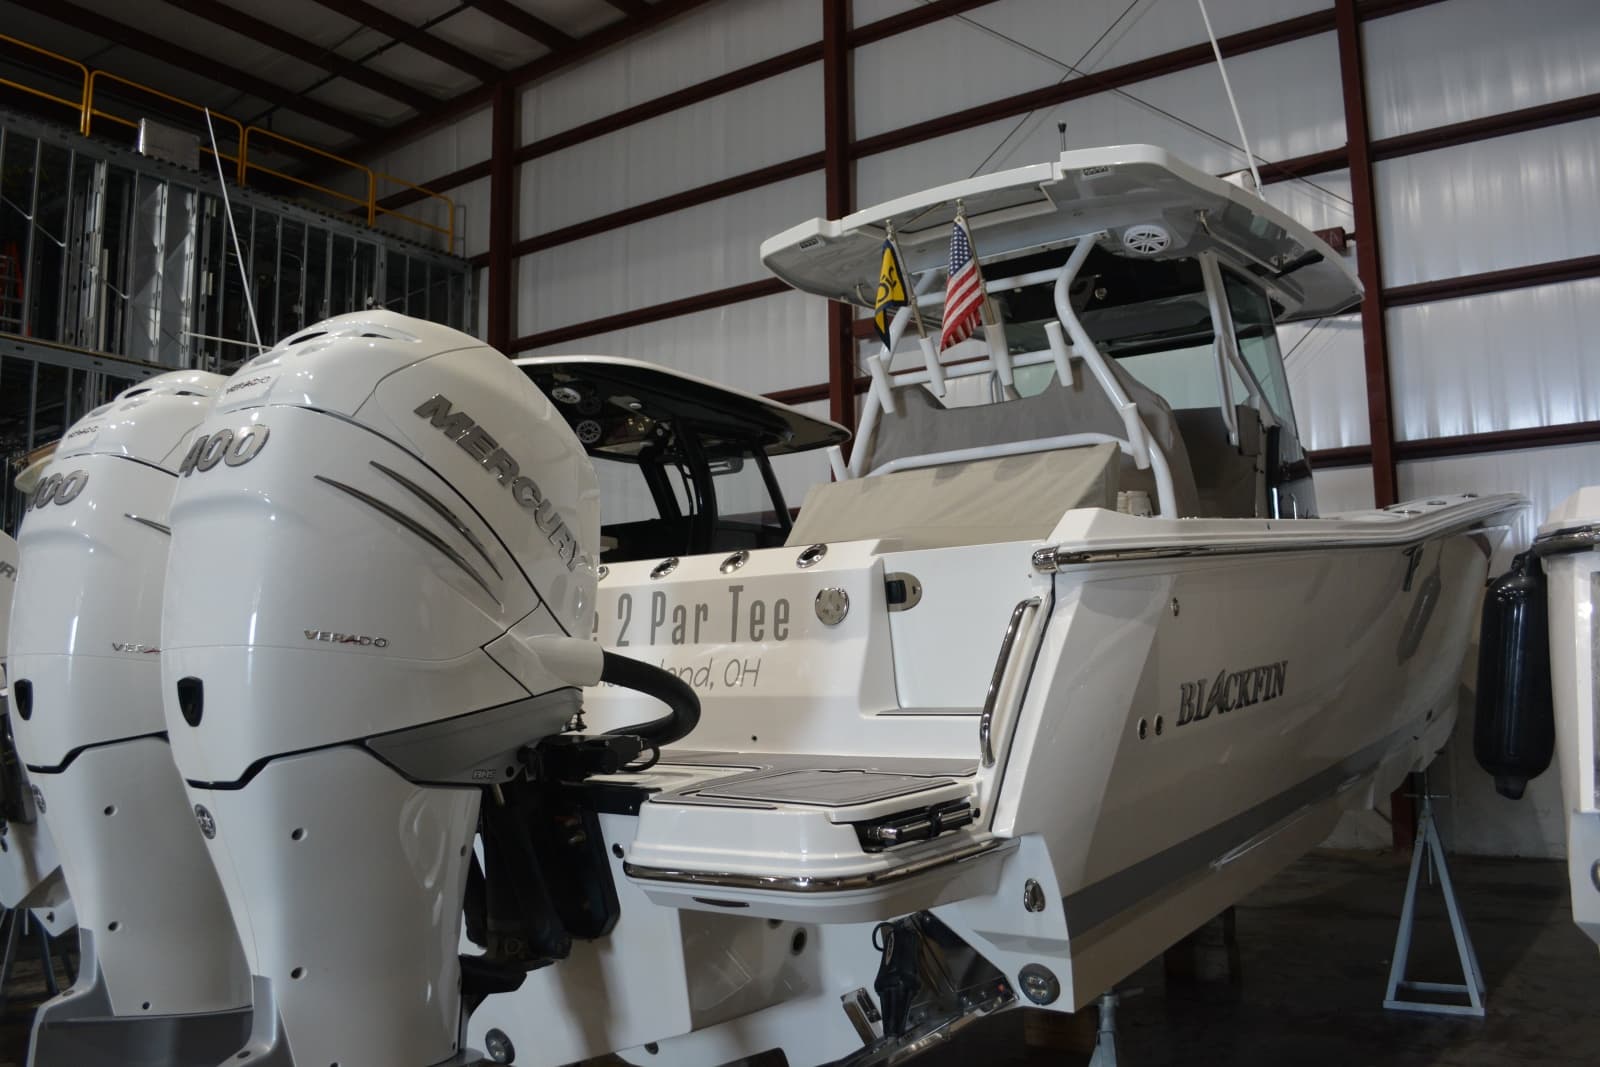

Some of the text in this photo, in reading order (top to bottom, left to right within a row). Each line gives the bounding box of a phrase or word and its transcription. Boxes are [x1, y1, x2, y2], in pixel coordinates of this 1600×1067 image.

[413, 393, 593, 572] MERCURY
[303, 630, 388, 648] VERADO
[616, 593, 633, 647] 2
[650, 591, 708, 645] Par
[729, 585, 790, 643] Tee
[724, 658, 762, 688] OH
[1176, 660, 1289, 727] BLACKFIN
